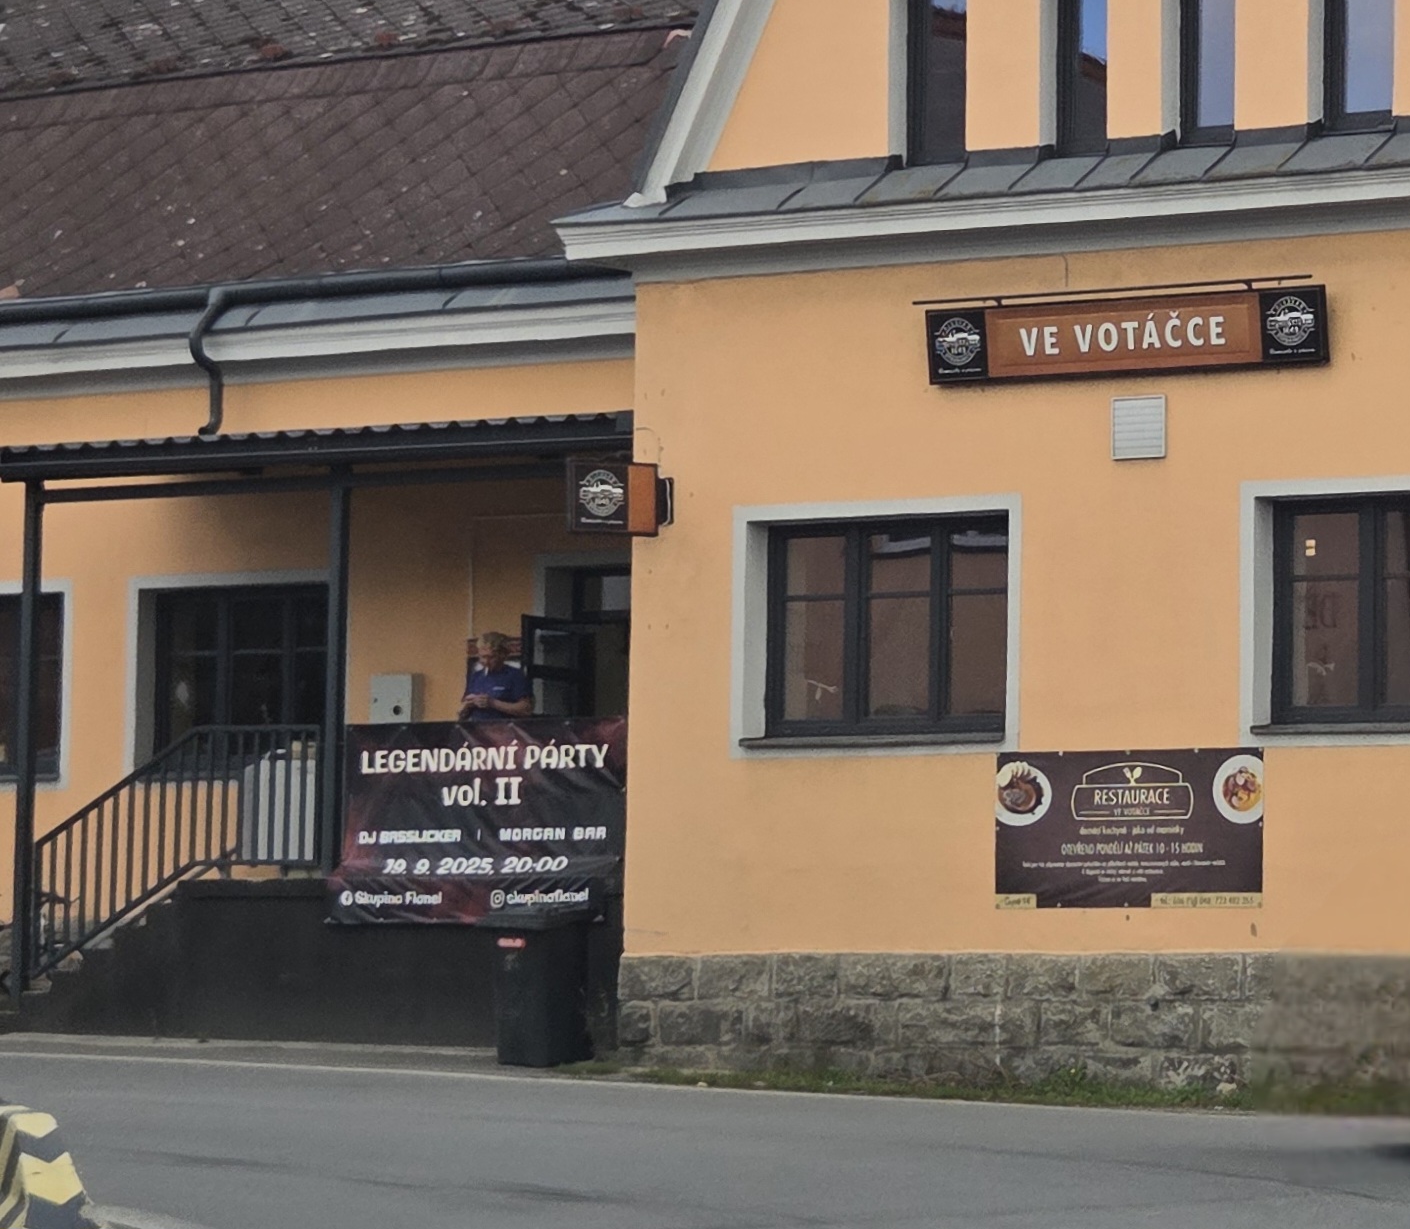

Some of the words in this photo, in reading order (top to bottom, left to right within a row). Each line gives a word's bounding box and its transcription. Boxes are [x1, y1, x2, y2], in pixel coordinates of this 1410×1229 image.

[1019, 326, 1060, 356] VE
[1074, 310, 1226, 353] VOTÁČCE
[360, 739, 519, 774] LEGENDÁRNÍ
[524, 739, 609, 771] PÁRTY
[442, 777, 488, 807] vol.
[494, 776, 523, 806] II
[1094, 788, 1170, 806] RESTAURACE
[358, 830, 377, 845] DJ
[499, 827, 566, 842] MORGAN
[573, 826, 607, 841] BAR
[382, 858, 407, 875] 19.
[413, 858, 431, 875] 9.
[501, 856, 569, 874] 20:00
